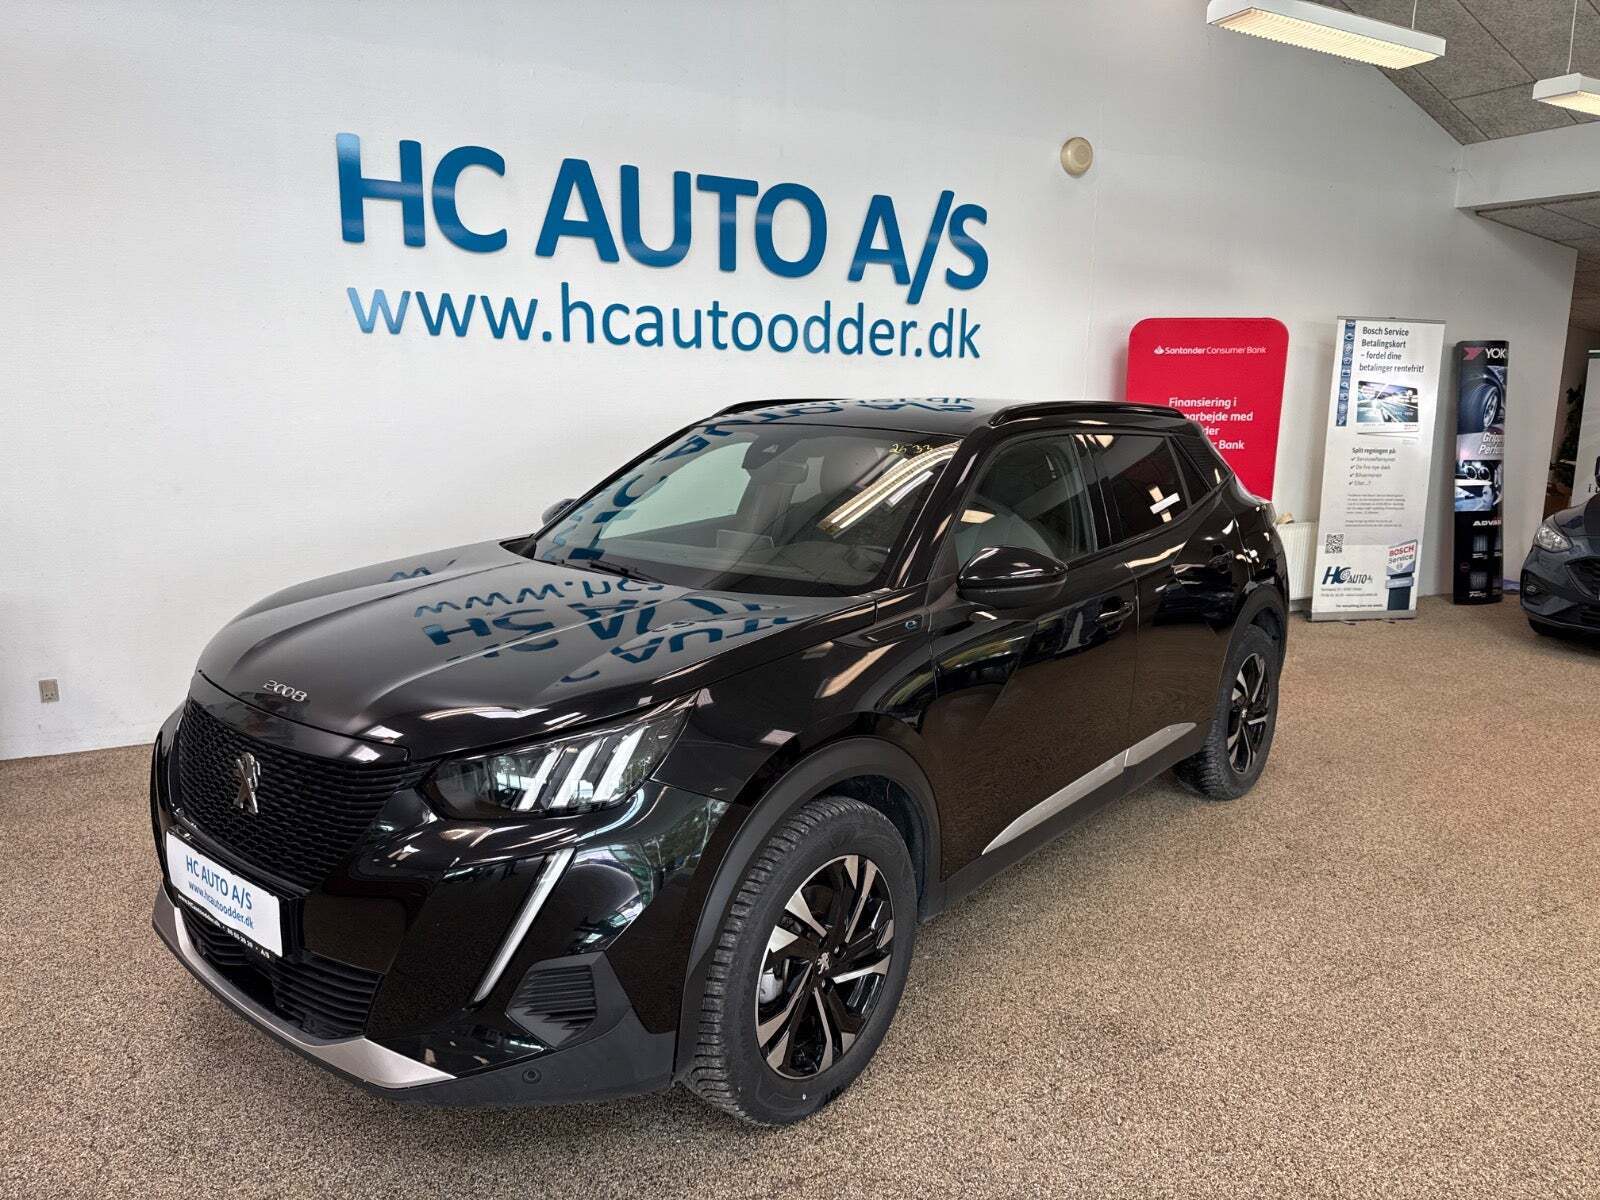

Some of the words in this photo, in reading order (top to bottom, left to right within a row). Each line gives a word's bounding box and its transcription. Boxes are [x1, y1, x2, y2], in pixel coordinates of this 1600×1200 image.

[335, 132, 508, 253] HC
[534, 157, 828, 278] AUTO
[847, 189, 989, 304] A/S
[346, 281, 981, 360] www.hcautoodder.dk
[1362, 326, 1383, 336] Bosch
[1384, 327, 1410, 337] Service
[1361, 339, 1407, 349] Betalingskort
[1164, 346, 1206, 355] Santander
[1206, 346, 1247, 354] Consumer
[1247, 346, 1267, 354] Bank
[1366, 351, 1386, 360] fordel
[1387, 352, 1402, 360] dine
[1359, 364, 1392, 373] betalinger
[1168, 396, 1232, 410] Finansiering
[1233, 397, 1238, 407] i
[1230, 411, 1254, 421] med
[1218, 440, 1246, 450] Bank
[1389, 544, 1415, 557] BOSCH
[1388, 554, 1414, 565] Service
[1346, 574, 1368, 585] AUTO
[263, 679, 308, 702] 2008
[186, 855, 200, 877] HC
[202, 865, 229, 897] AUTO
[231, 885, 253, 910] A/S
[188, 880, 255, 930] www.hcautoodder.dk
